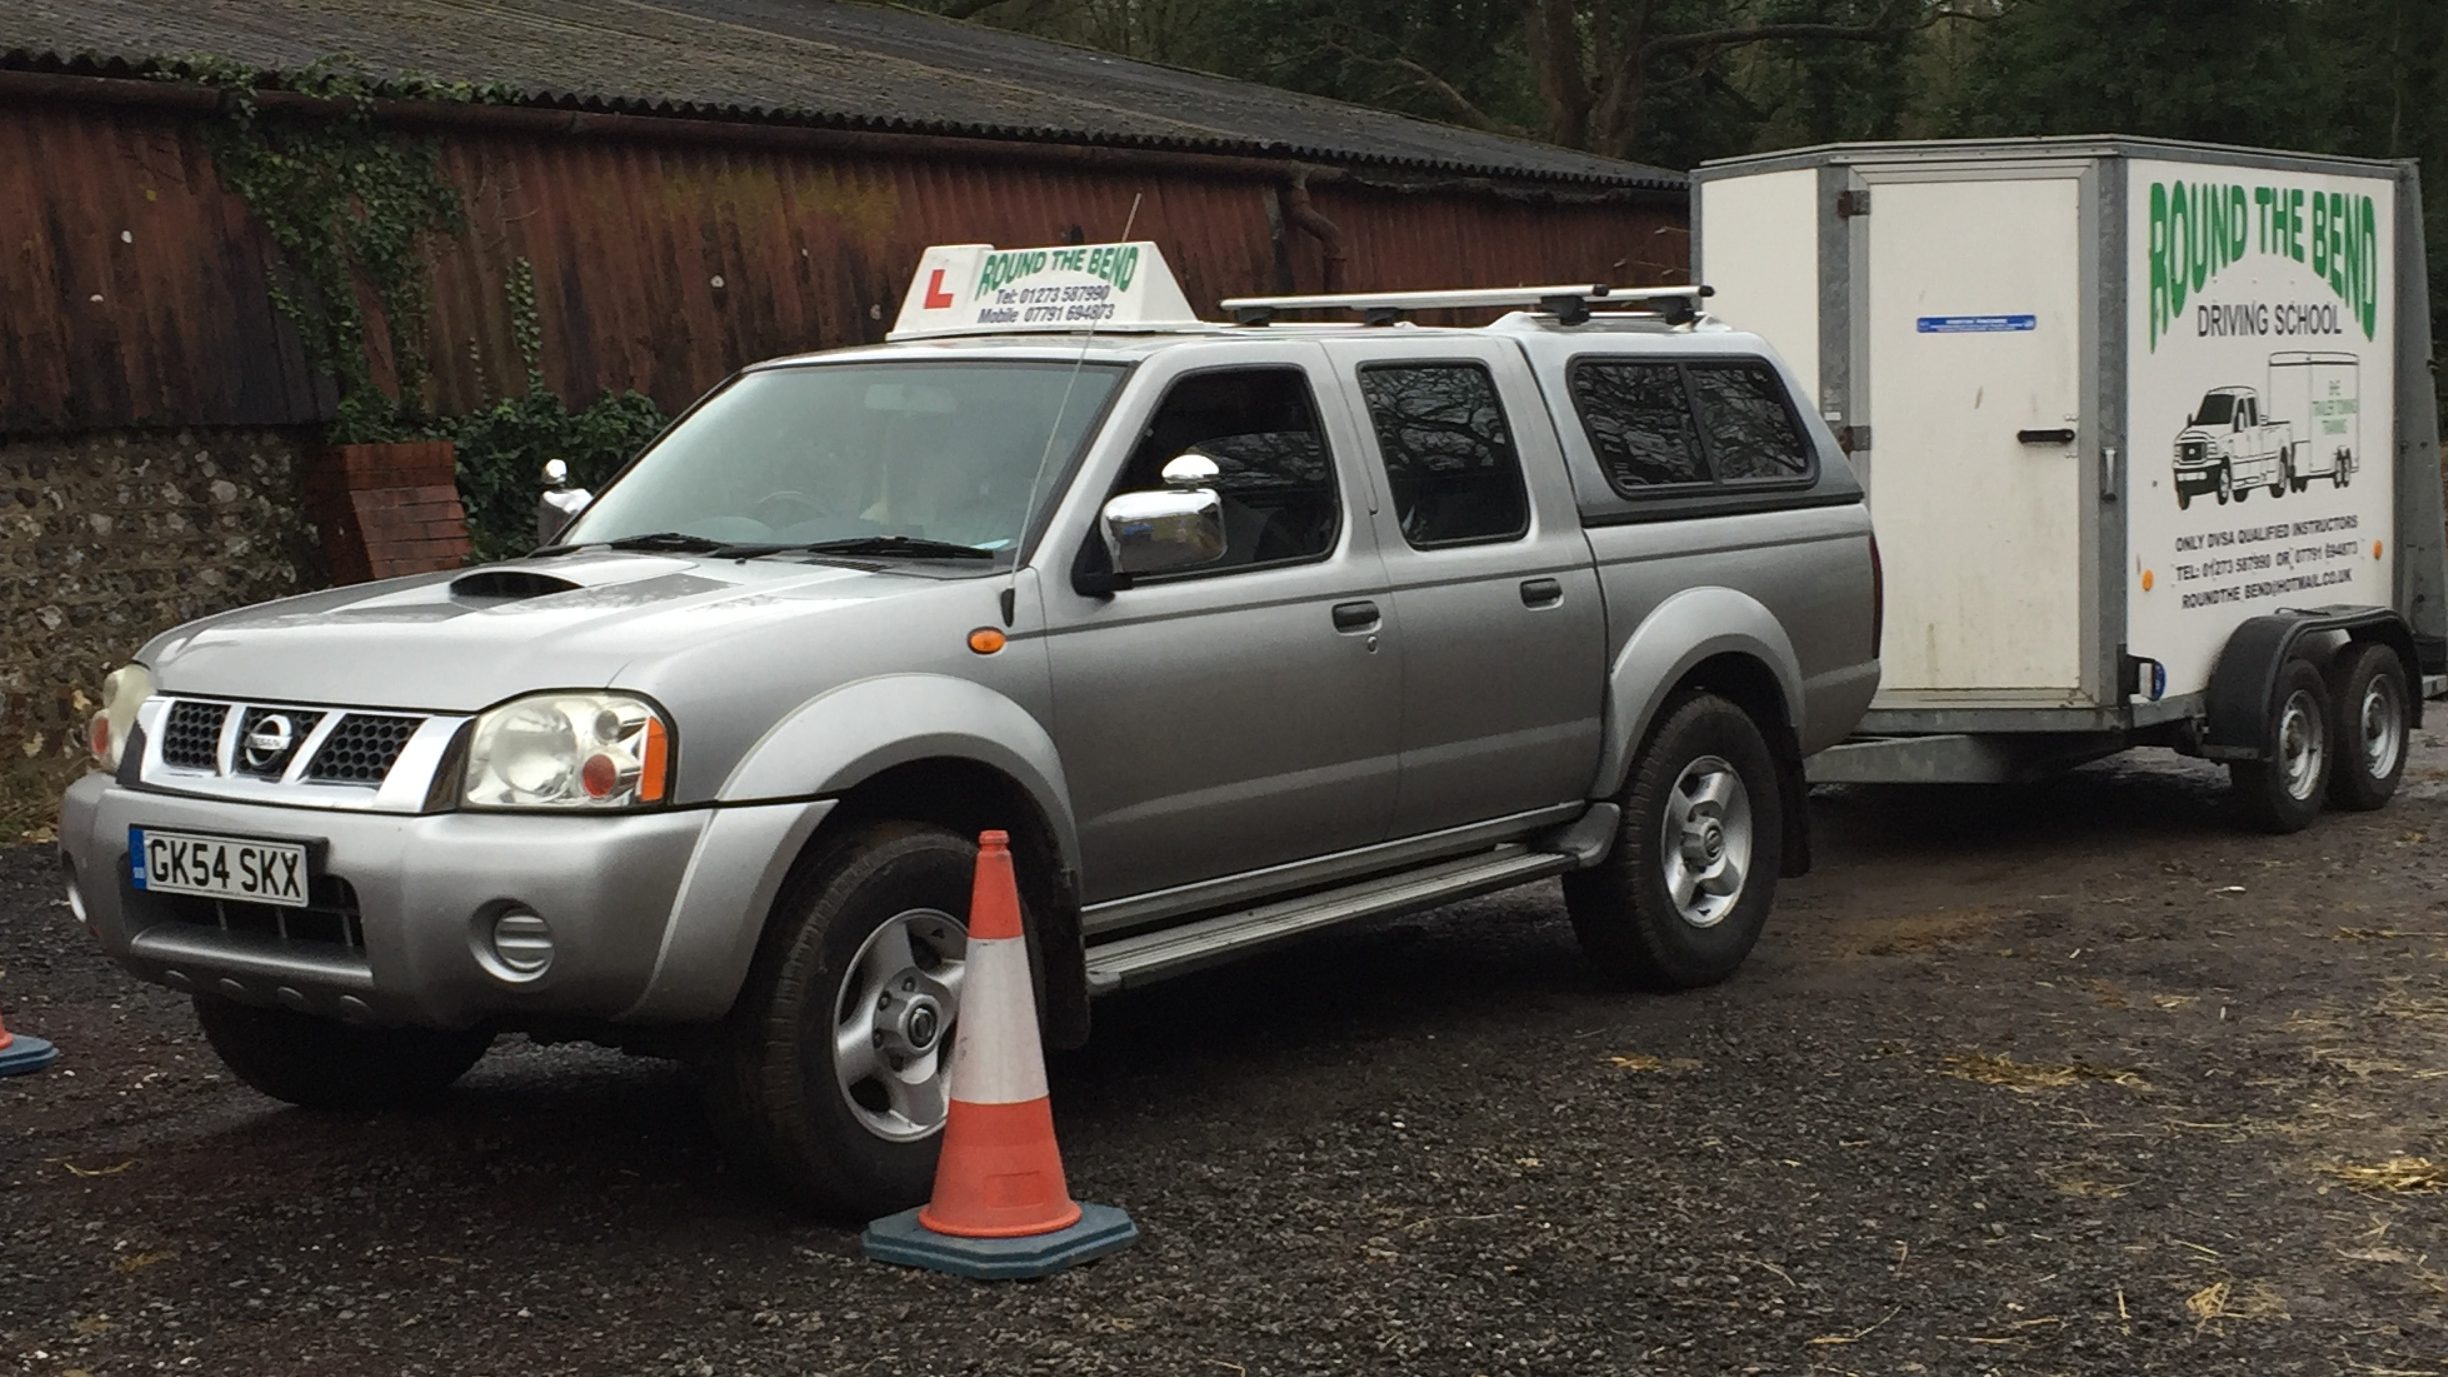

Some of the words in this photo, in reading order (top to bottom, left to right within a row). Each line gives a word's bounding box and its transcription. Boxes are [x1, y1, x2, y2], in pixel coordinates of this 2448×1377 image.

[976, 251, 1046, 299] ROUND
[1052, 249, 1083, 272] THE
[1088, 246, 1139, 292] BEND
[2150, 180, 2247, 353] ROUND
[2255, 187, 2304, 262] THE
[2314, 191, 2376, 341] BEND
[924, 269, 953, 308] L
[996, 288, 1018, 304] Tel:
[1021, 288, 1059, 303] 01273
[1062, 286, 1110, 301] 587990
[978, 309, 1018, 323] Mobile
[1025, 307, 1063, 321] 07791
[1067, 305, 1114, 320] 694873
[2198, 305, 2268, 336] DRIVING
[2275, 305, 2342, 334] SCHOOL
[2176, 536, 2204, 552] ONLY
[2208, 531, 2234, 547] DVSA
[2238, 524, 2289, 544] QUALIFIED
[2293, 515, 2358, 536] INSTRUCTORS
[2176, 565, 2199, 582] TEL:
[2203, 559, 2232, 577] 01273
[2276, 551, 2291, 567] OR
[151, 840, 230, 889] GK54
[241, 849, 300, 897] SKX
